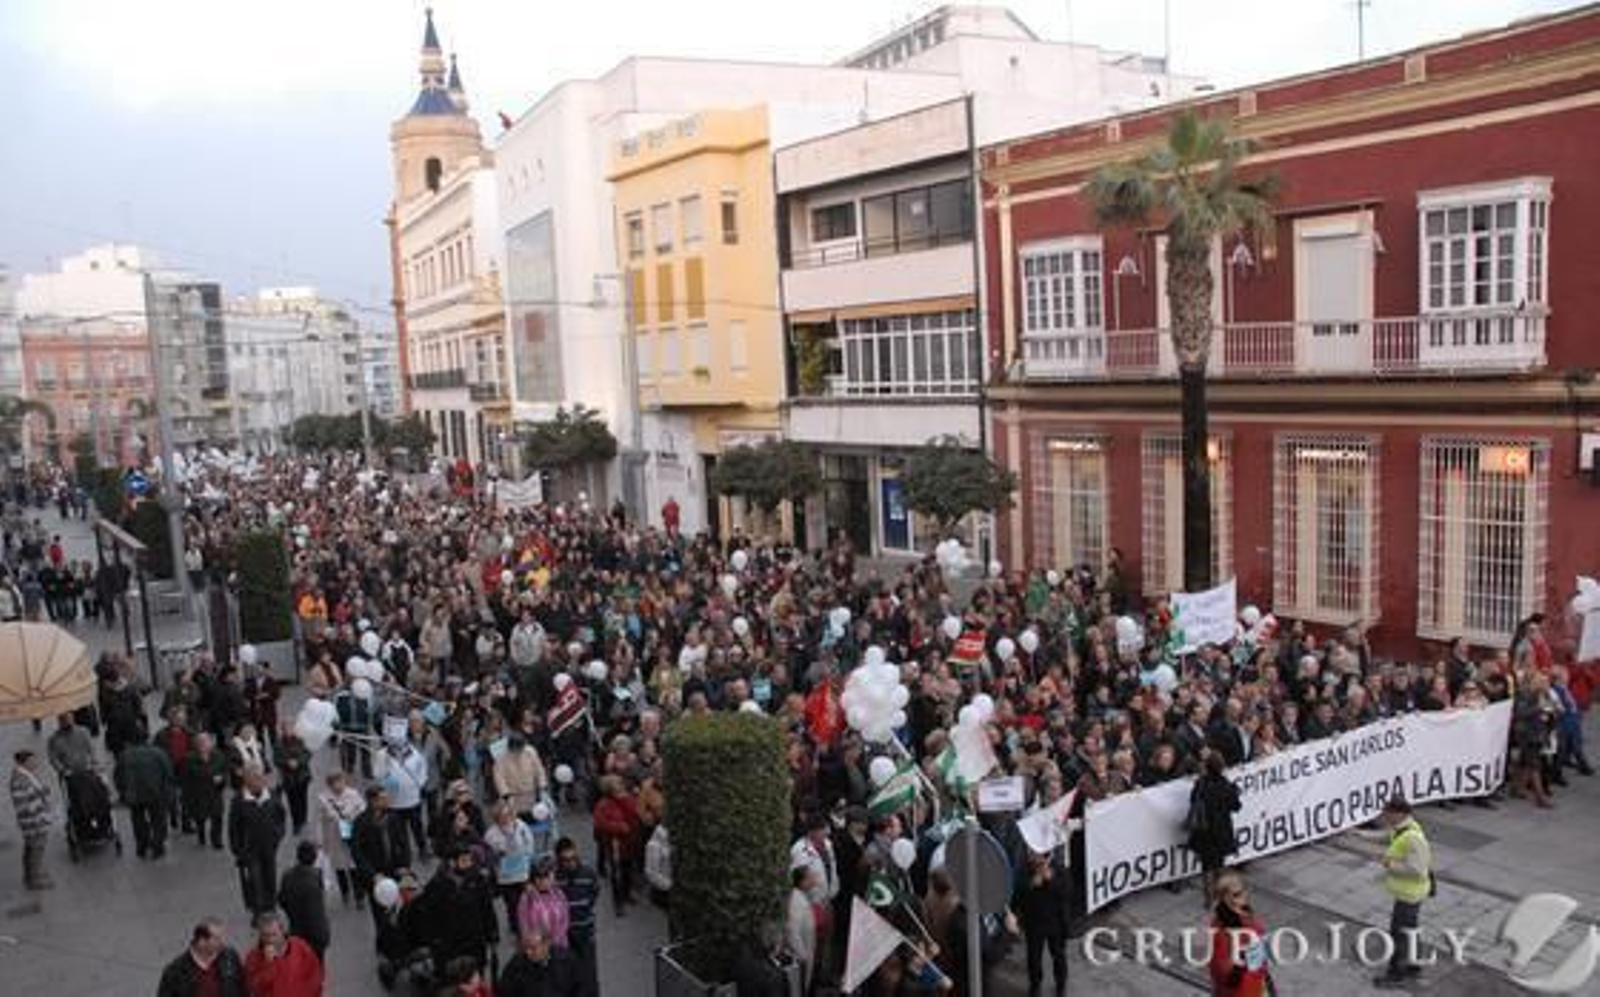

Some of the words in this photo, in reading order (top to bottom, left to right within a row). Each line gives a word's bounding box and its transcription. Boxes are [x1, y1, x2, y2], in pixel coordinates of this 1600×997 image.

[1290, 756, 1311, 780] DE
[1315, 745, 1350, 772] SAN
[1352, 727, 1405, 763] CARLOS
[1235, 798, 1346, 858] PÚBLICO
[1348, 775, 1405, 822] PARA
[1412, 767, 1446, 799] LA
